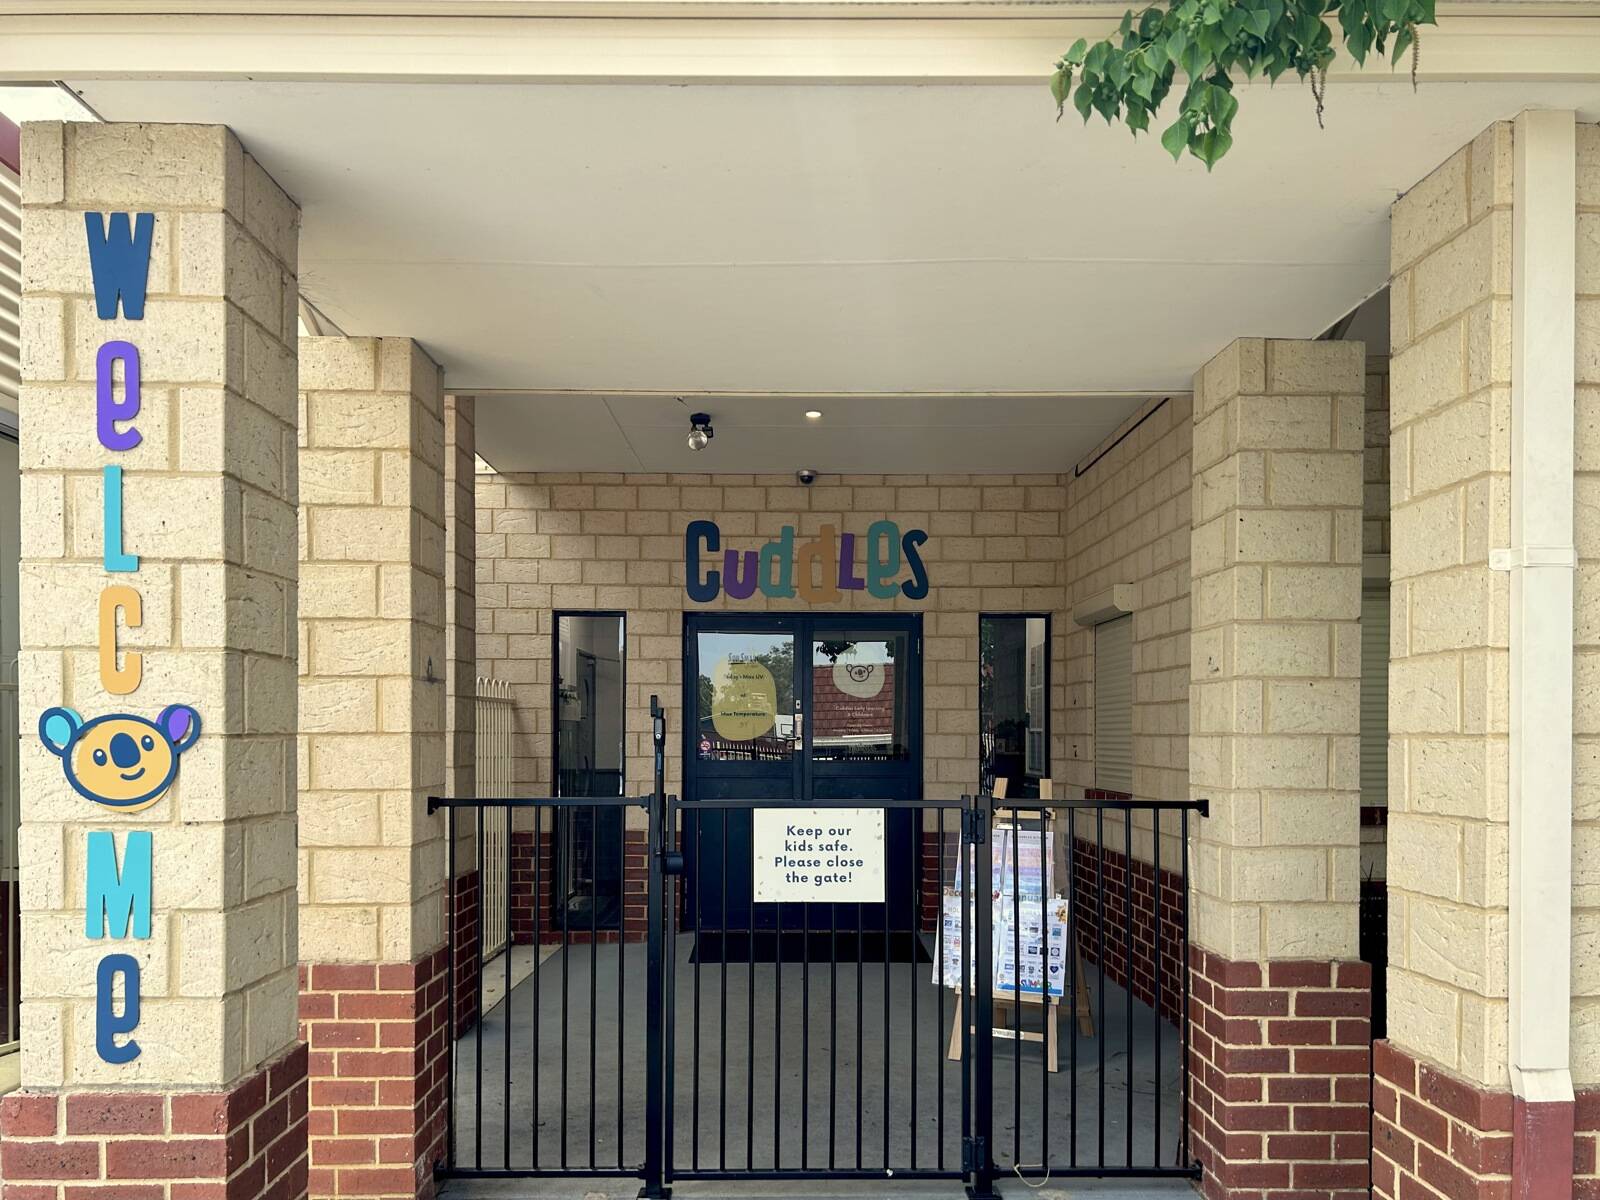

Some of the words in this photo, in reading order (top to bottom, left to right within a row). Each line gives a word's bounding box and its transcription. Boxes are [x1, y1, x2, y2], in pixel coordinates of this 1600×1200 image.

[686, 520, 929, 603] CuddLes
[787, 825, 823, 839] Keep
[828, 828, 852, 836] our
[785, 840, 813, 851] kids
[819, 839, 853, 851] safe.
[775, 855, 821, 867] Please
[826, 855, 864, 867] close
[785, 871, 808, 883] the
[814, 872, 852, 887] gate!
